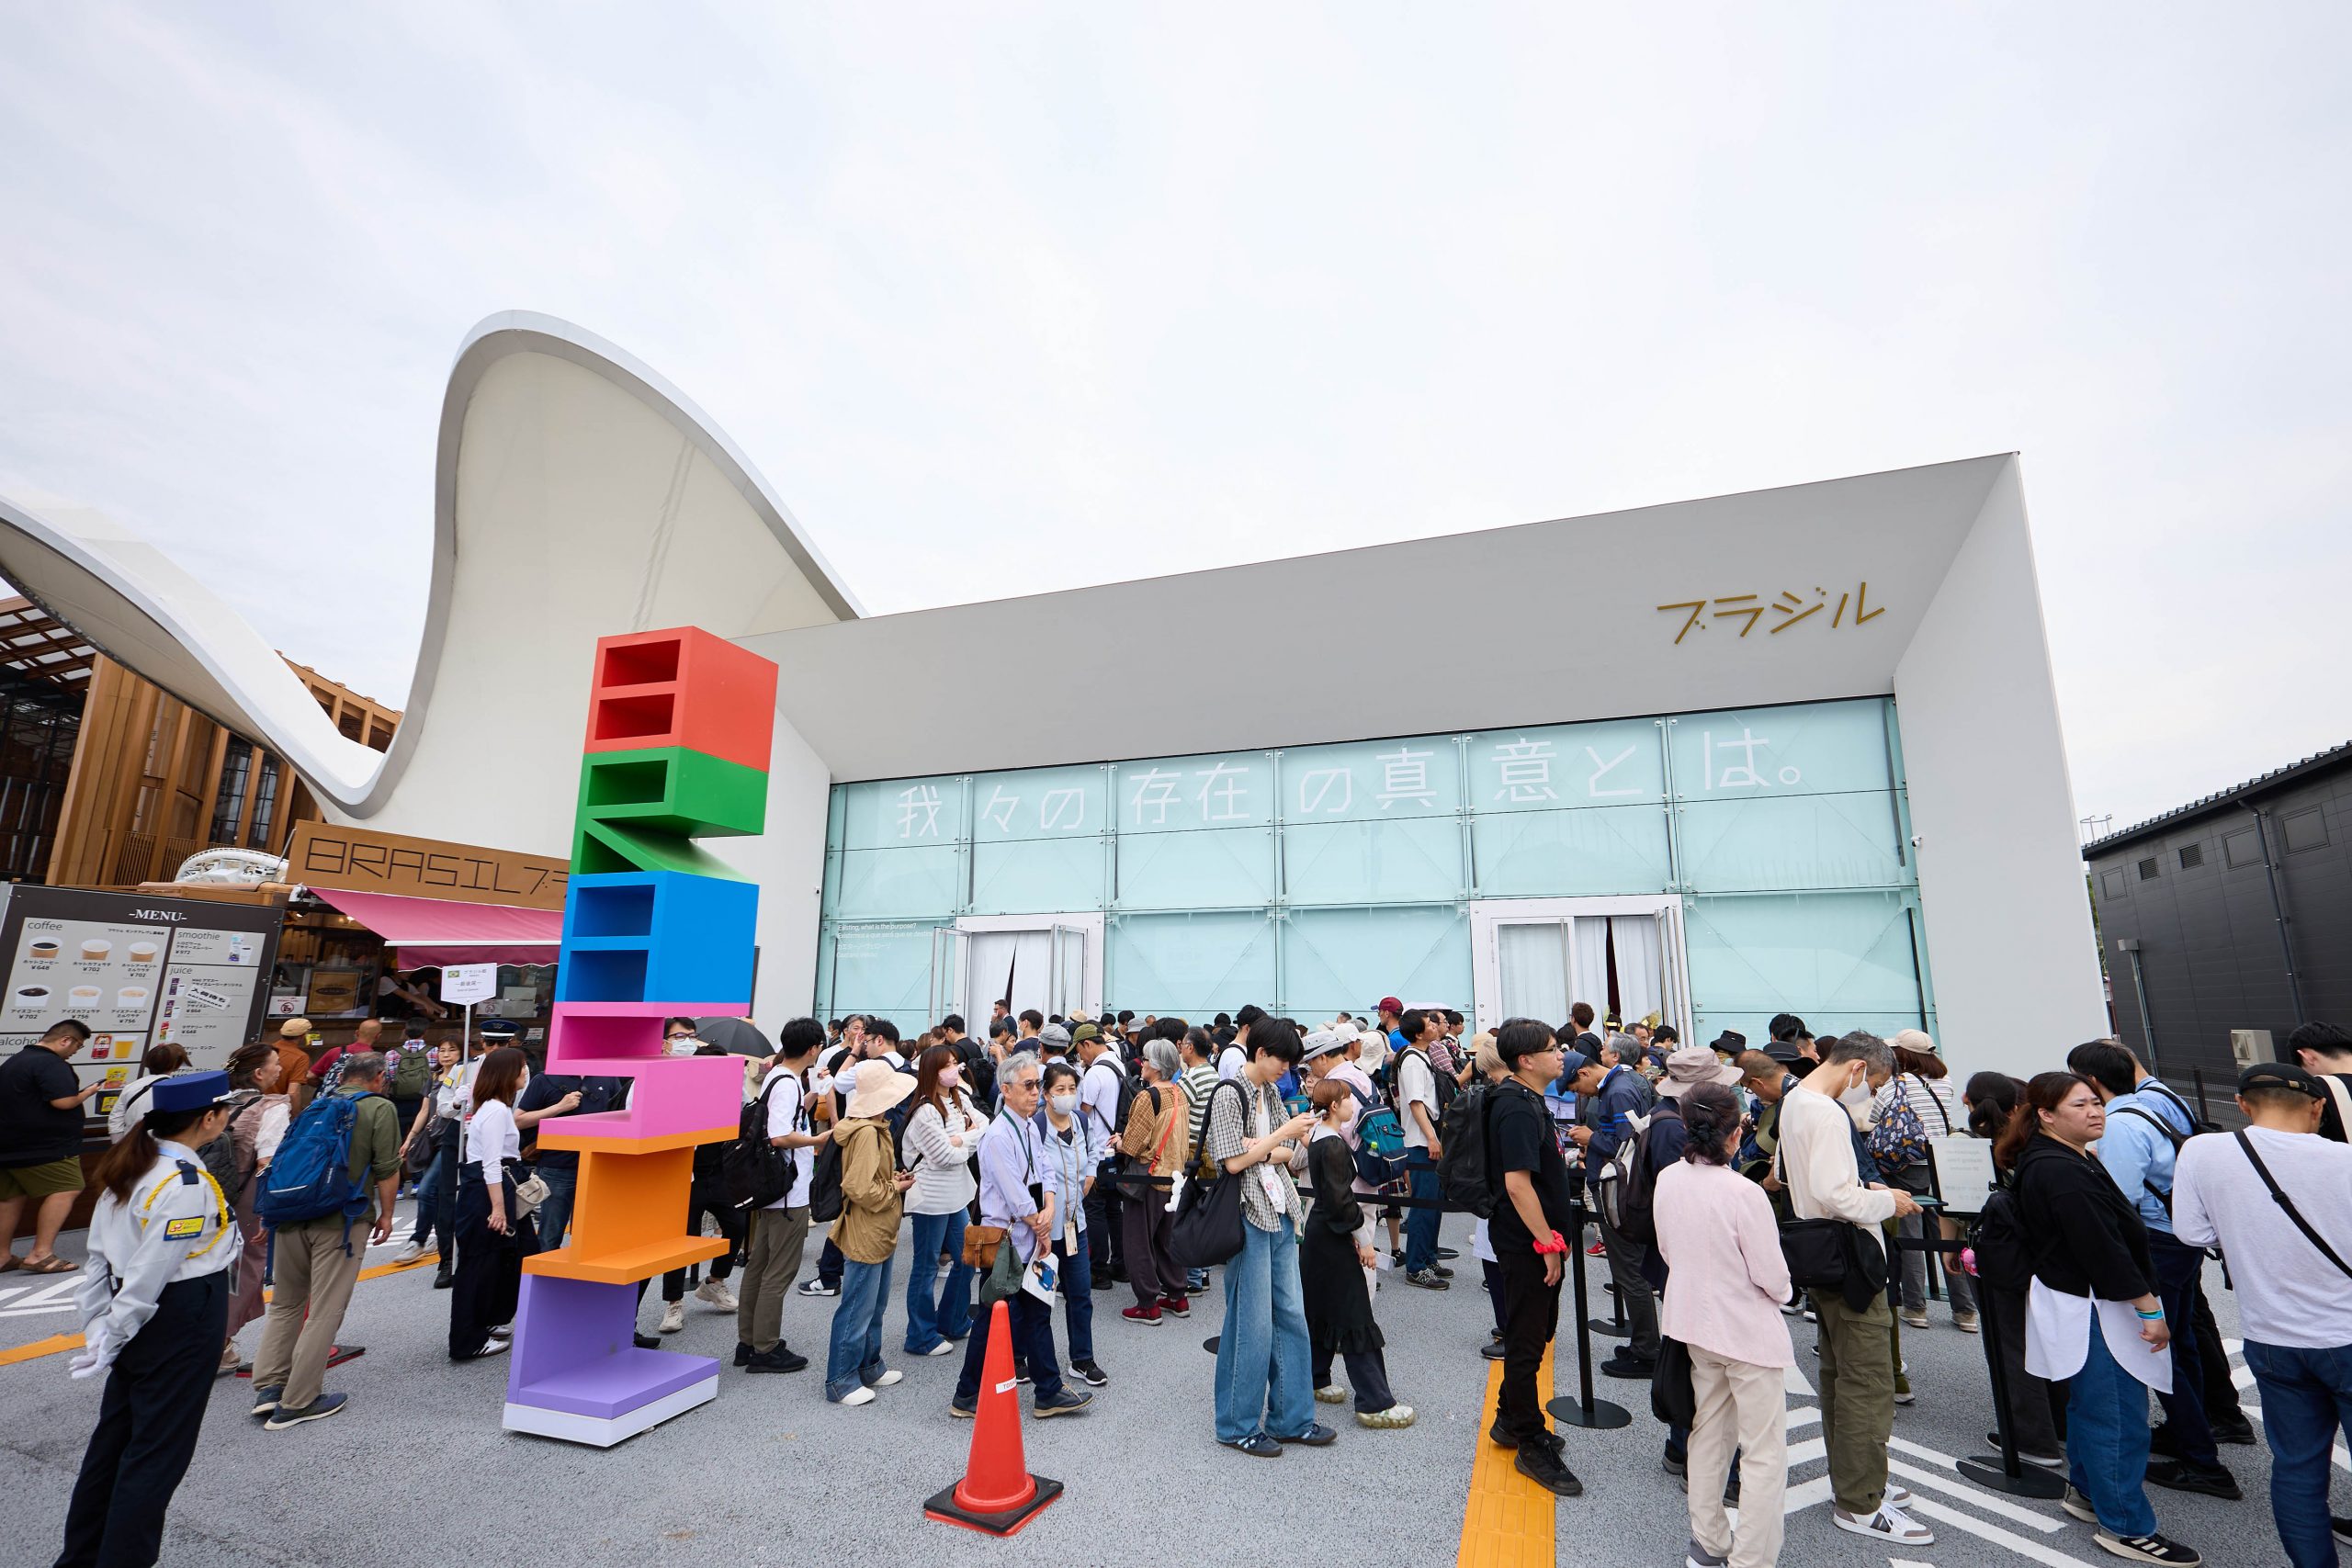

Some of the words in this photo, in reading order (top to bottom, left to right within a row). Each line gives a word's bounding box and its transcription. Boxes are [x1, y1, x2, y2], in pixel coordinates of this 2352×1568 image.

[1657, 581, 1885, 645] ブラジル
[896, 728, 1802, 839] 我々の存在の真意とは。
[305, 837, 521, 894] BRASIL
[28, 921, 63, 931] coffee
[177, 931, 221, 941] smoothie
[169, 966, 193, 976] juice
